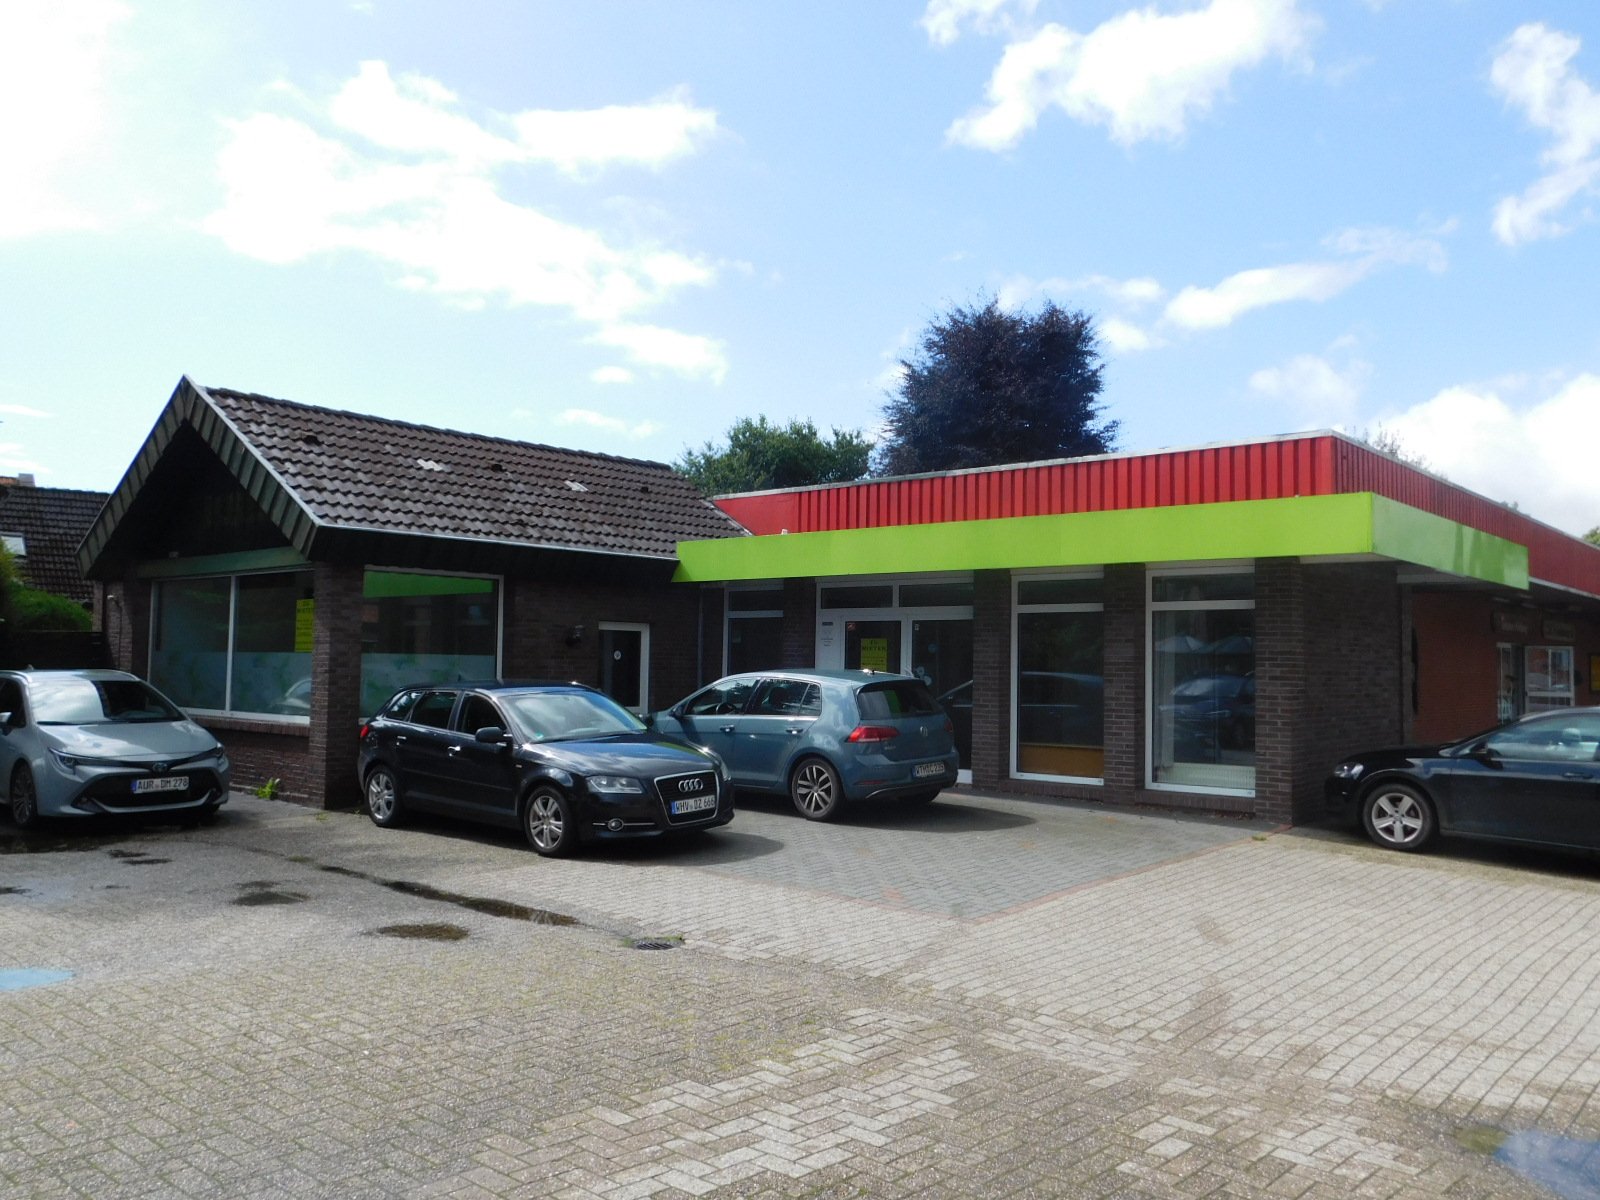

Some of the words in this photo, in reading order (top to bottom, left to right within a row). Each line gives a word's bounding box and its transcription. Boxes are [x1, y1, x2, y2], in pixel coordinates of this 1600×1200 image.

[137, 780, 154, 790] AUR
[173, 777, 188, 788] 278
[675, 801, 689, 812] WHV
[703, 796, 715, 807] 666
